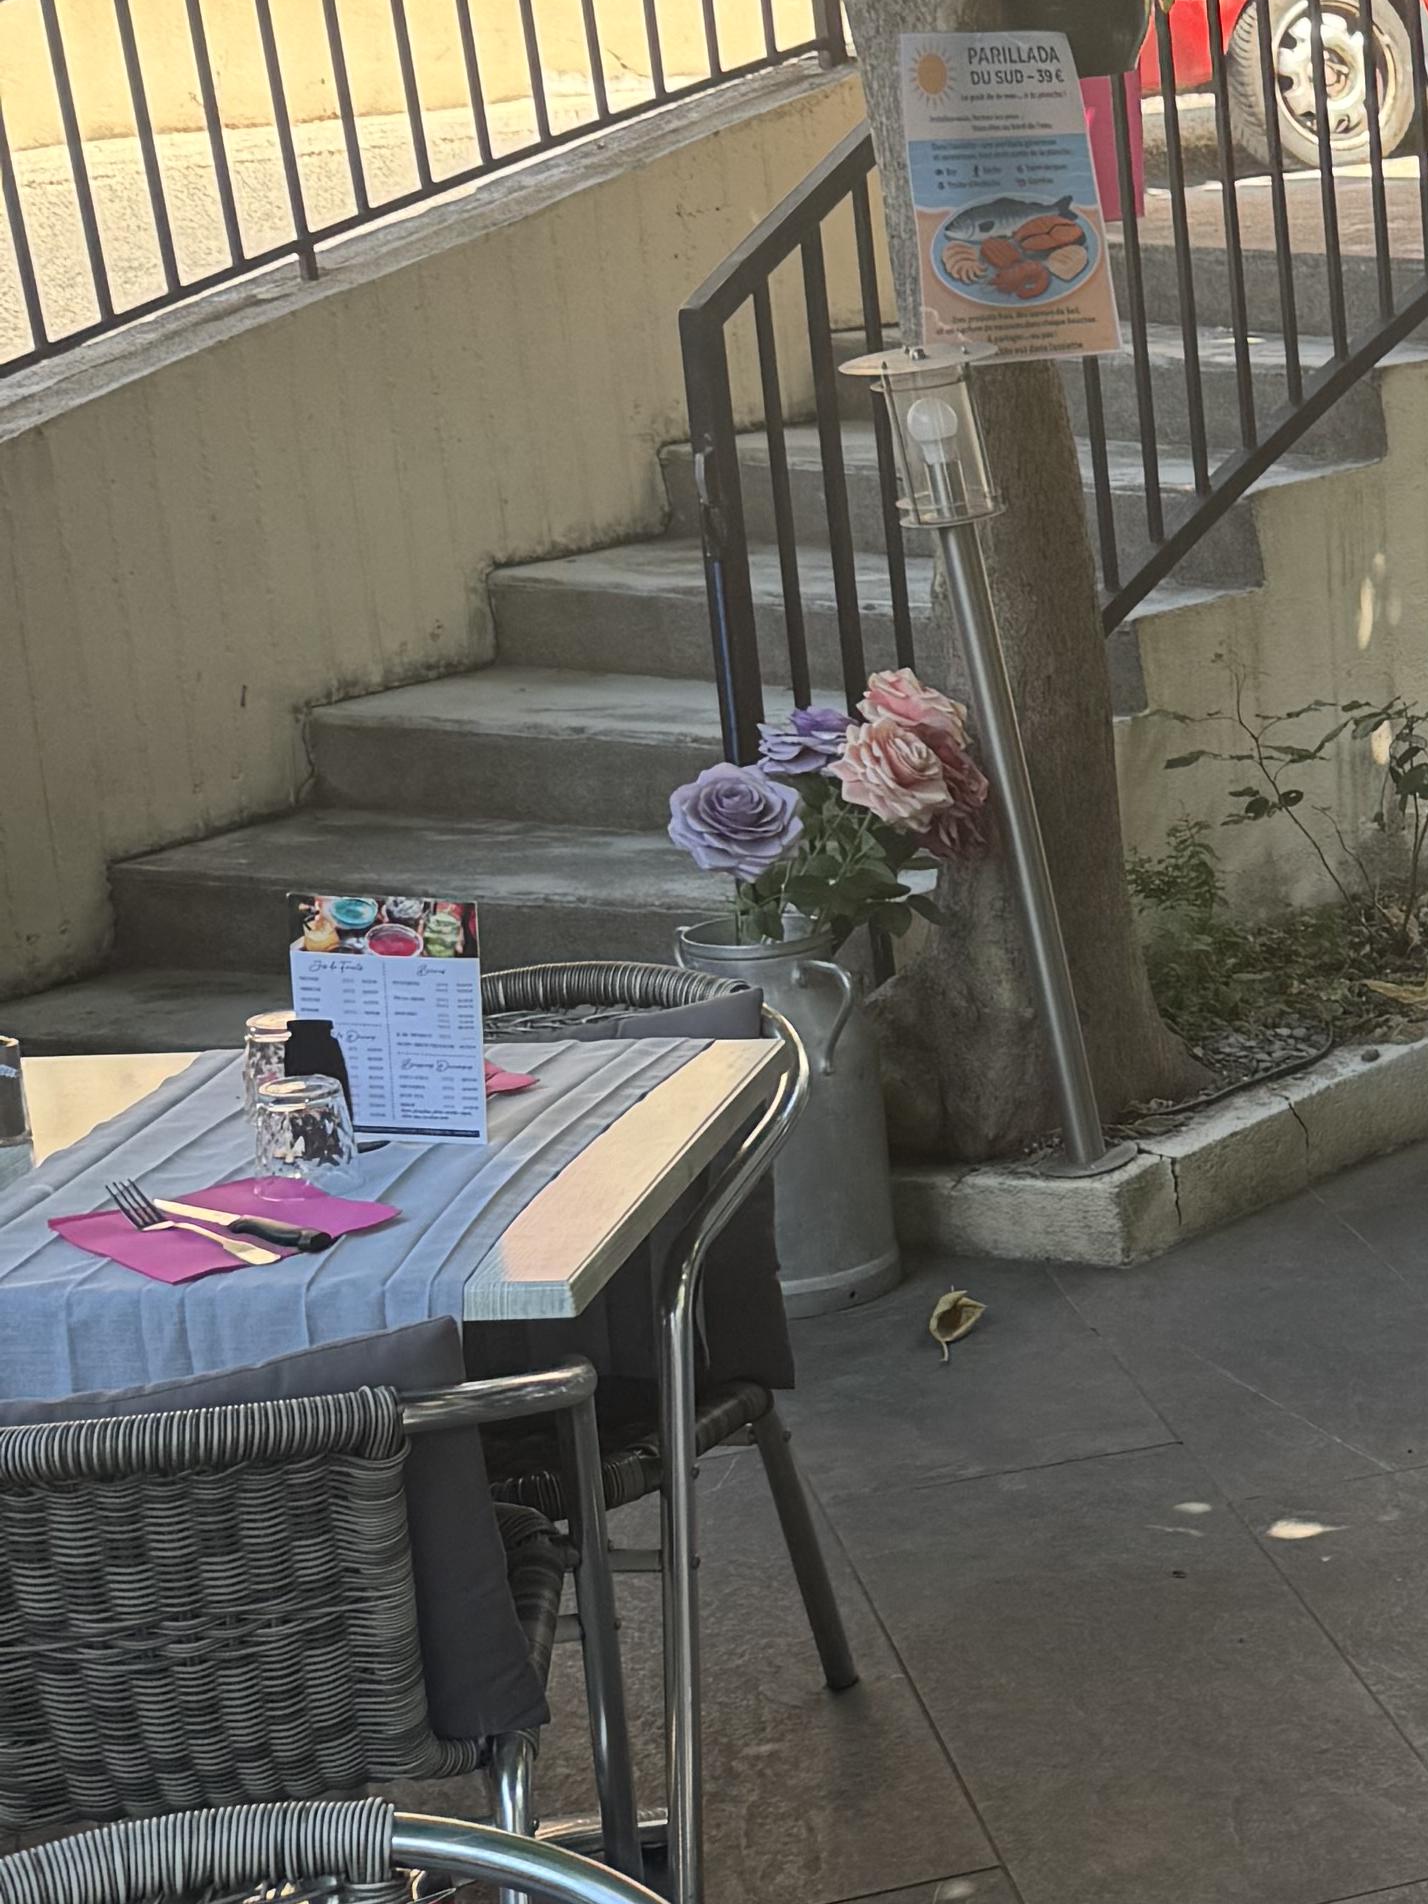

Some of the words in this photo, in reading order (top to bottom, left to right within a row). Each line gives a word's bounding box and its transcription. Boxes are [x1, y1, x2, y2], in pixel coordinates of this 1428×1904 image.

[967, 45, 1061, 65] PARILLADA
[970, 70, 991, 86] DU
[995, 69, 1024, 85] SUD
[1037, 68, 1053, 83] 39
[1055, 68, 1065, 83] €
